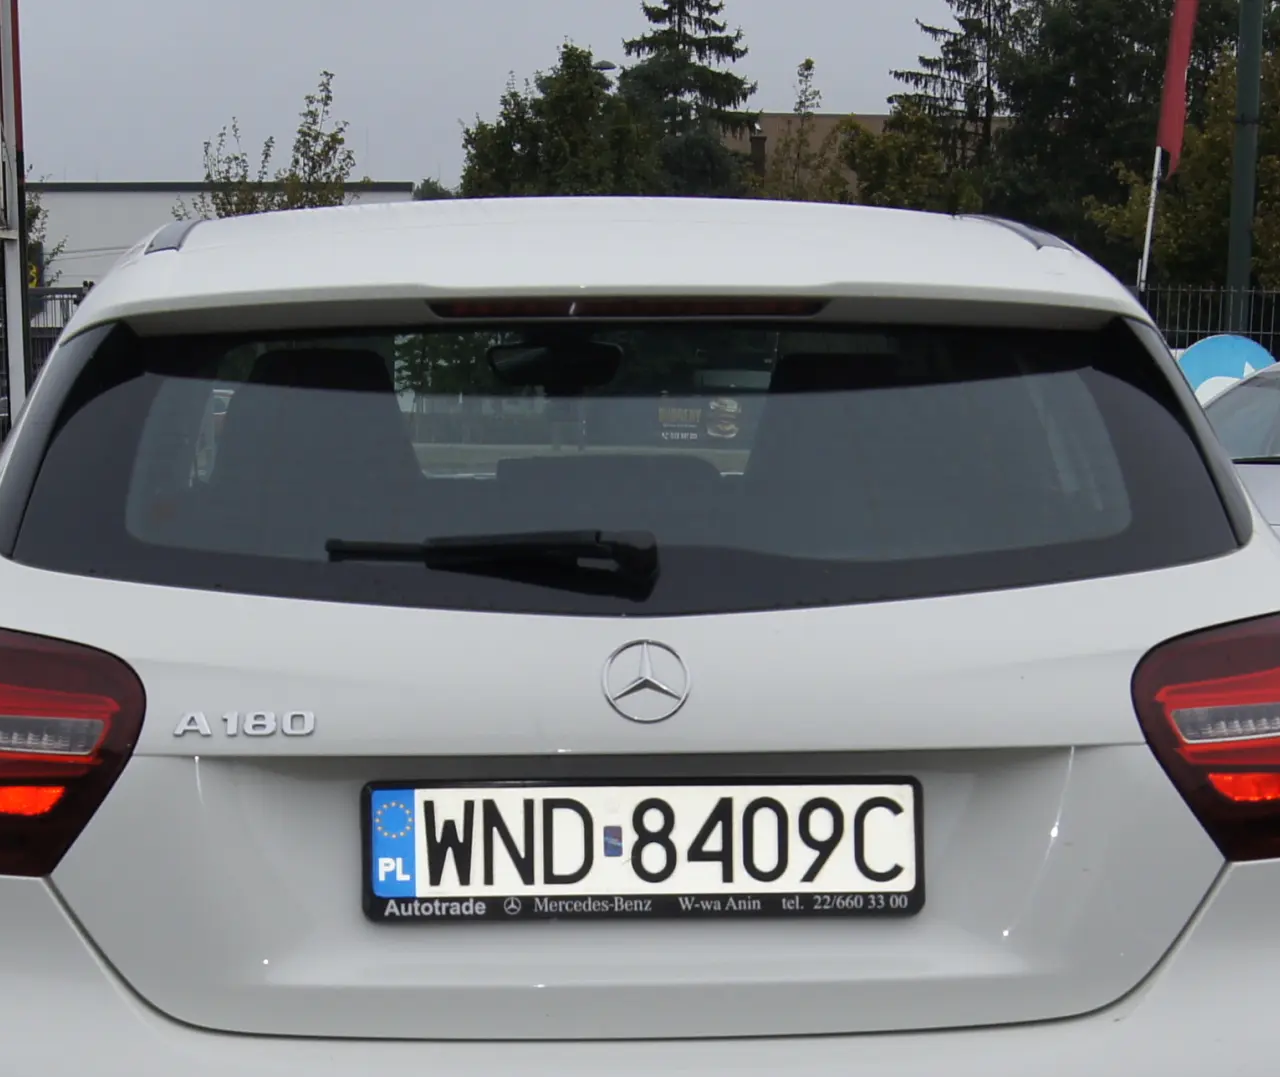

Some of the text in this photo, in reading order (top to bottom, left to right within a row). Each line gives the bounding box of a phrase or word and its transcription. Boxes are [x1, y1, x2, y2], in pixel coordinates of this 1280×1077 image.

[423, 795, 905, 886] WND 8409C
[378, 857, 411, 882] PL
[384, 893, 909, 917] Autotrade Mercedes-Benz W-wa Anin tel. 22/660 33 00
